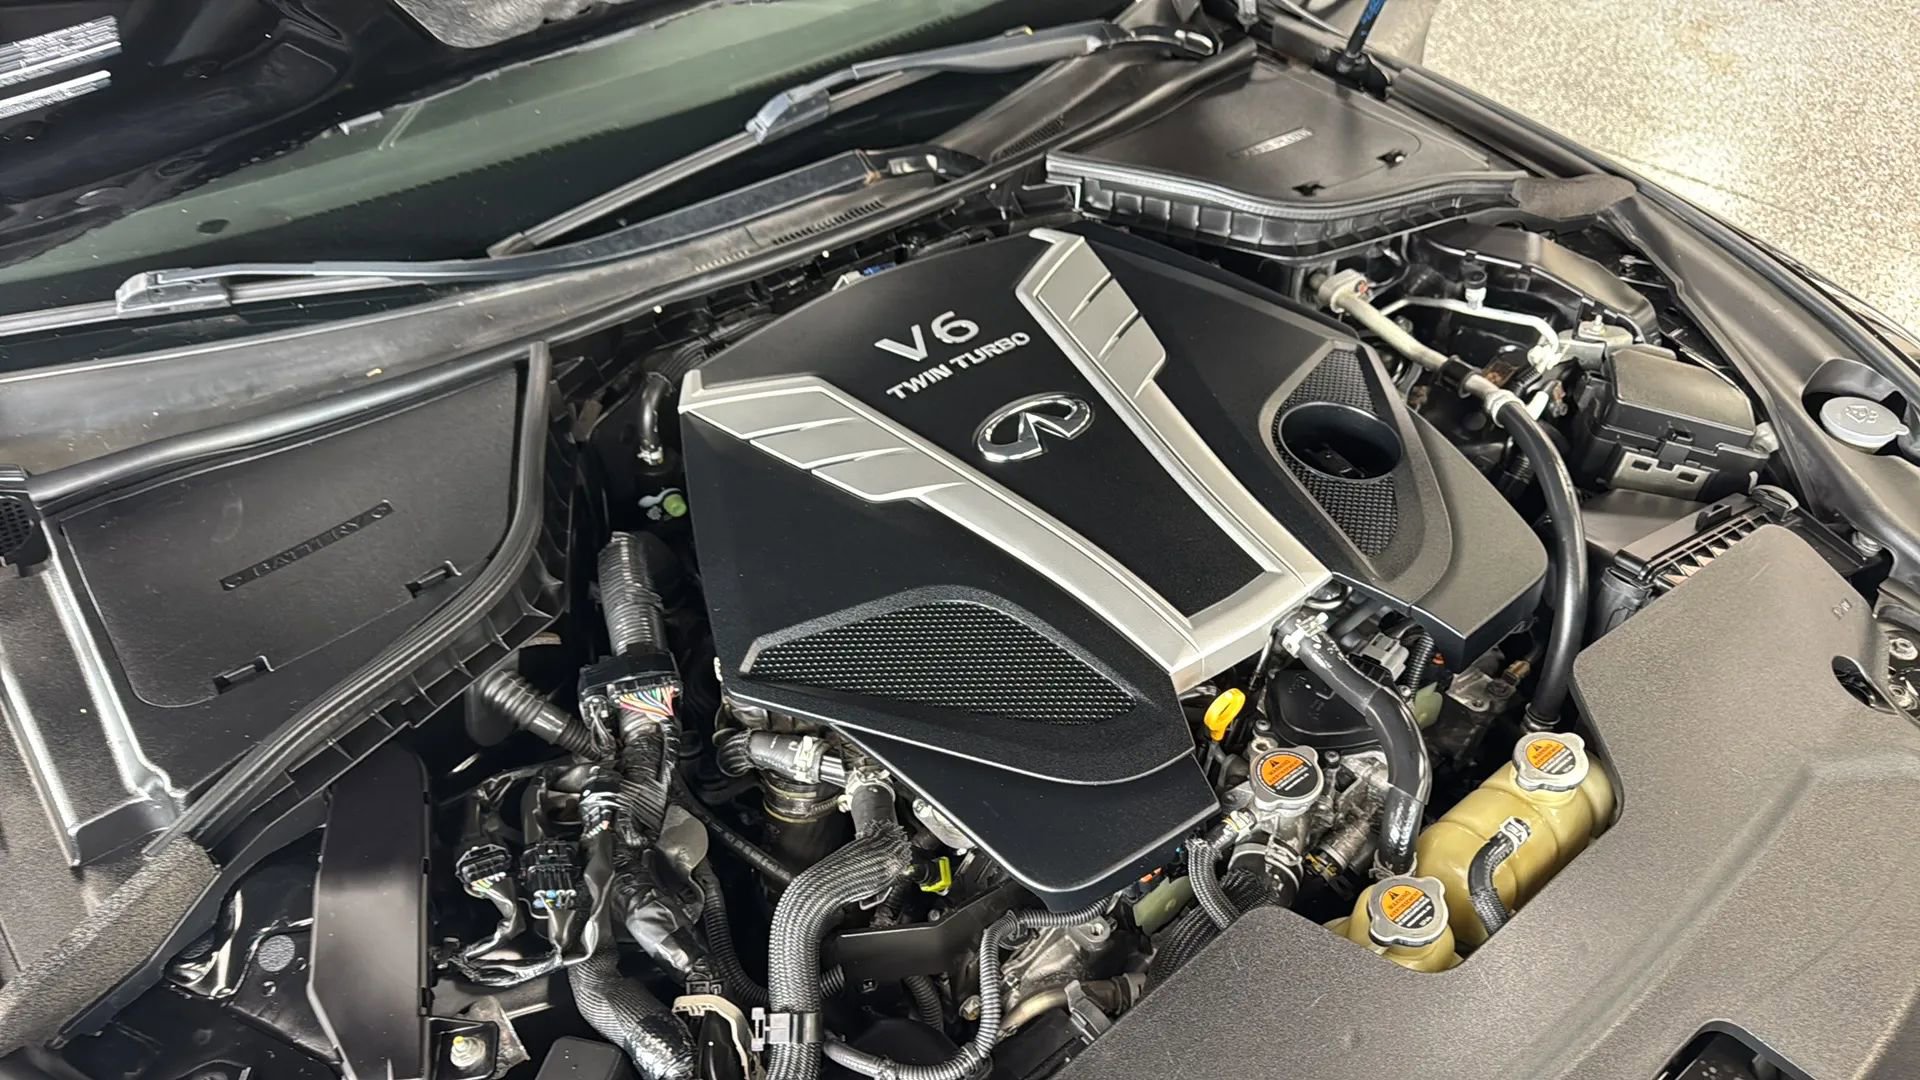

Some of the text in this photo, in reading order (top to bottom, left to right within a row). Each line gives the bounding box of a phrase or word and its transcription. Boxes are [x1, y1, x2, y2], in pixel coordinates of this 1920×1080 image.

[874, 310, 980, 362] V6
[886, 332, 1030, 400] TWIN TURBO
[253, 520, 361, 577] BATTERY
